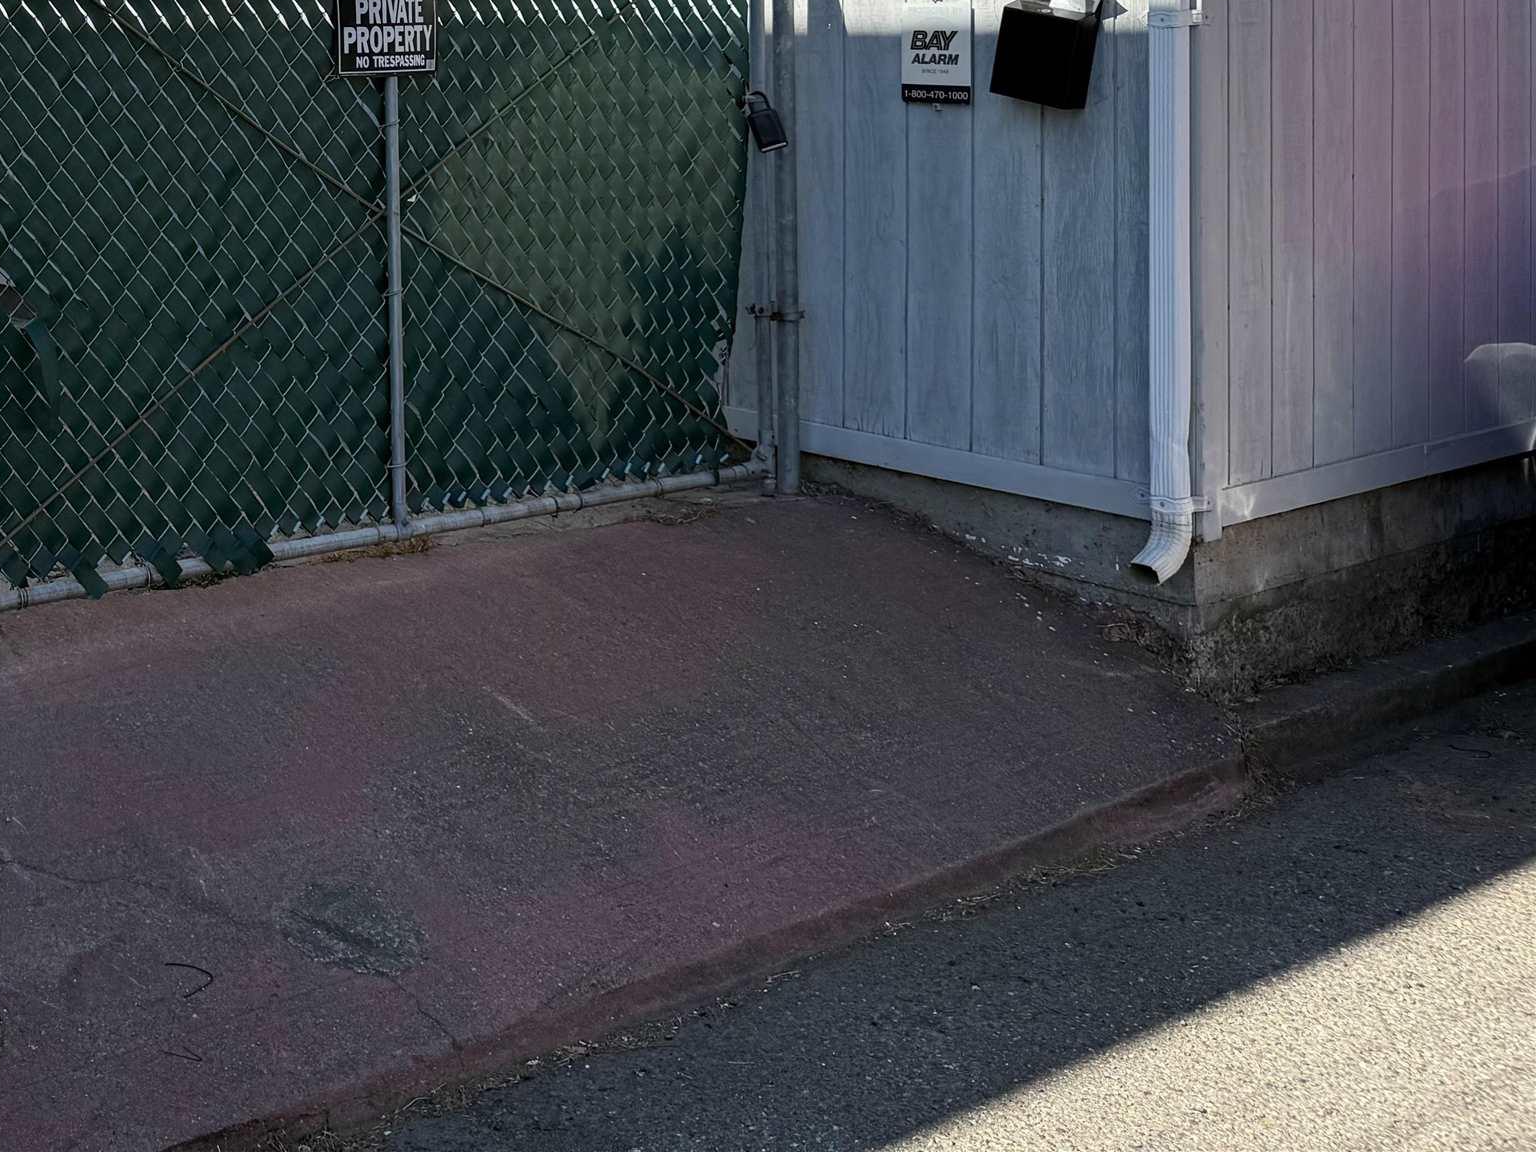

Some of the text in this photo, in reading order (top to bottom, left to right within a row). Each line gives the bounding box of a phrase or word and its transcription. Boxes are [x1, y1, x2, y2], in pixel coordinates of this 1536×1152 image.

[344, 24, 432, 54] PROPERTY
[910, 30, 959, 51] BAY
[356, 54, 425, 68] NO TRESPASSING
[911, 53, 959, 65] ALARM
[904, 89, 968, 100] 1-800-470-1000
